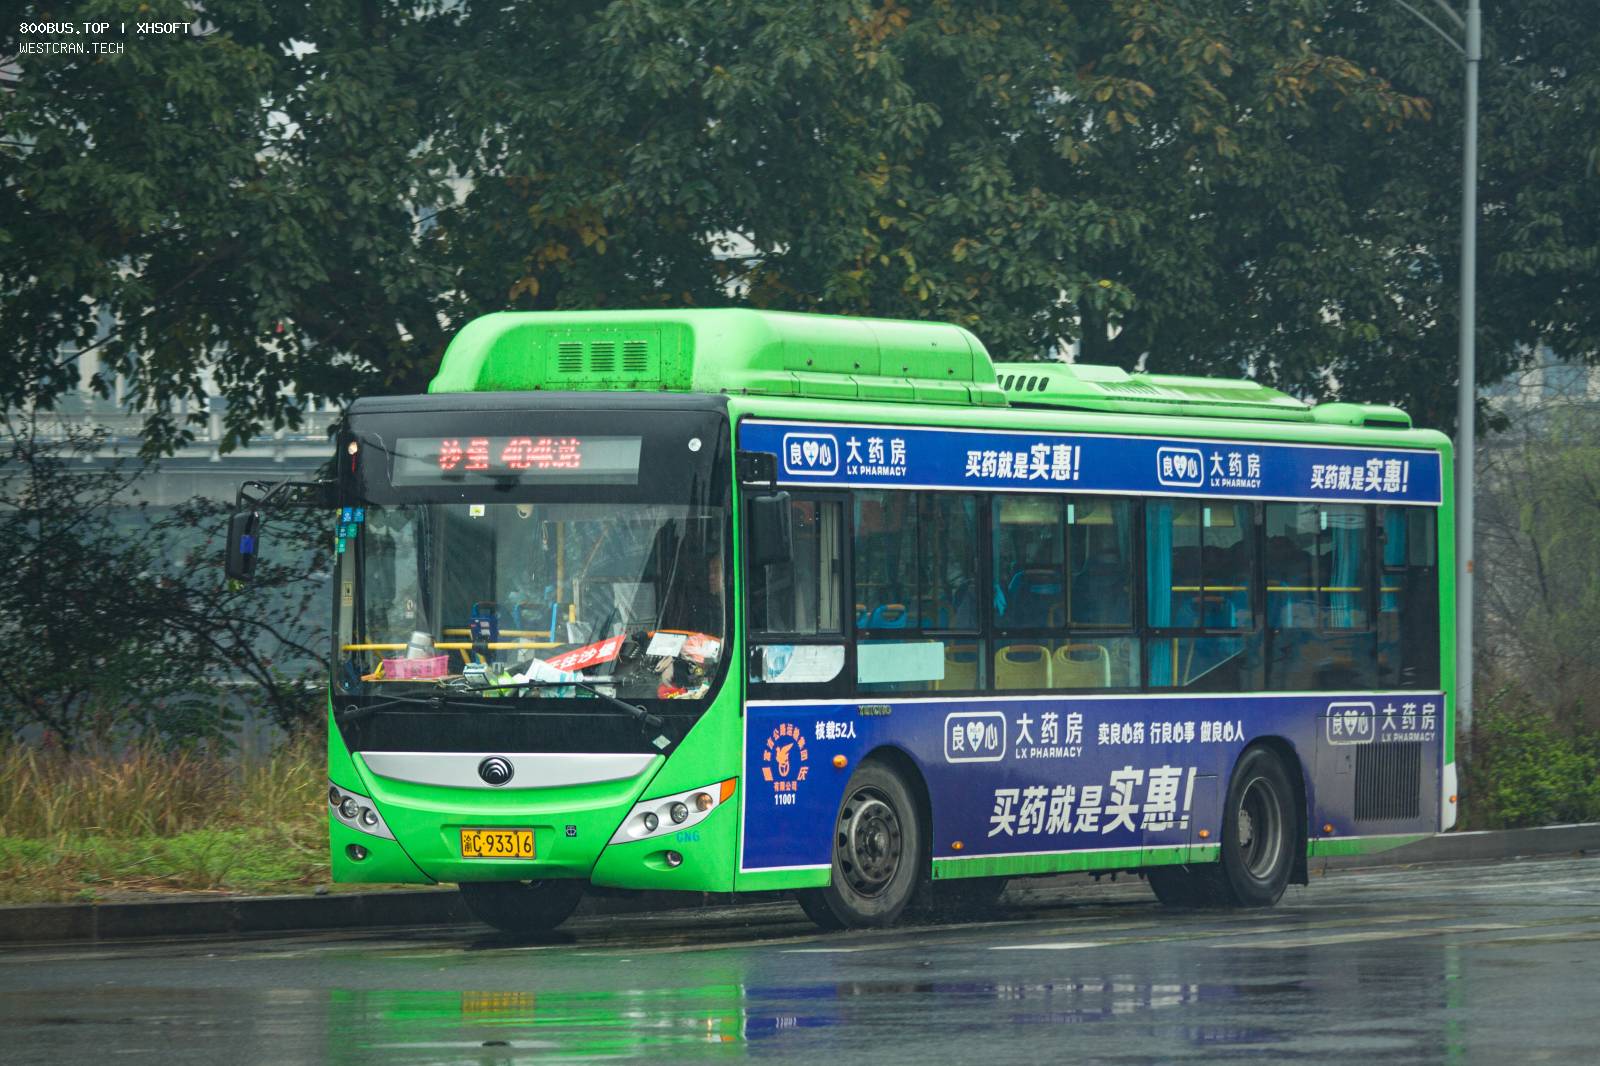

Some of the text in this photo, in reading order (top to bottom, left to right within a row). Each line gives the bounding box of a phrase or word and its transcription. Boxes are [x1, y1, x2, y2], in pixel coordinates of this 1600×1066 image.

[846, 436, 906, 465] 大药房
[965, 443, 1080, 481] 买药就是实惠!
[847, 465, 906, 476] LX PHARMACY
[1210, 451, 1261, 478] 大药房
[1310, 458, 1409, 493] 买药就是实惠!
[1211, 478, 1261, 488] LX PHARMACY
[1015, 712, 1084, 745] 大药房
[1382, 703, 1436, 730] 大药房
[815, 721, 857, 740] 核载52人
[1098, 720, 1245, 745] 卖良心药 行良心事 做良心人
[1382, 732, 1436, 742] LX PHARMACY
[1015, 746, 1082, 759] LX PHARMACY
[774, 794, 796, 806] 11001
[987, 765, 1197, 838] 买药就是实惠!
[676, 831, 699, 843] CNG
